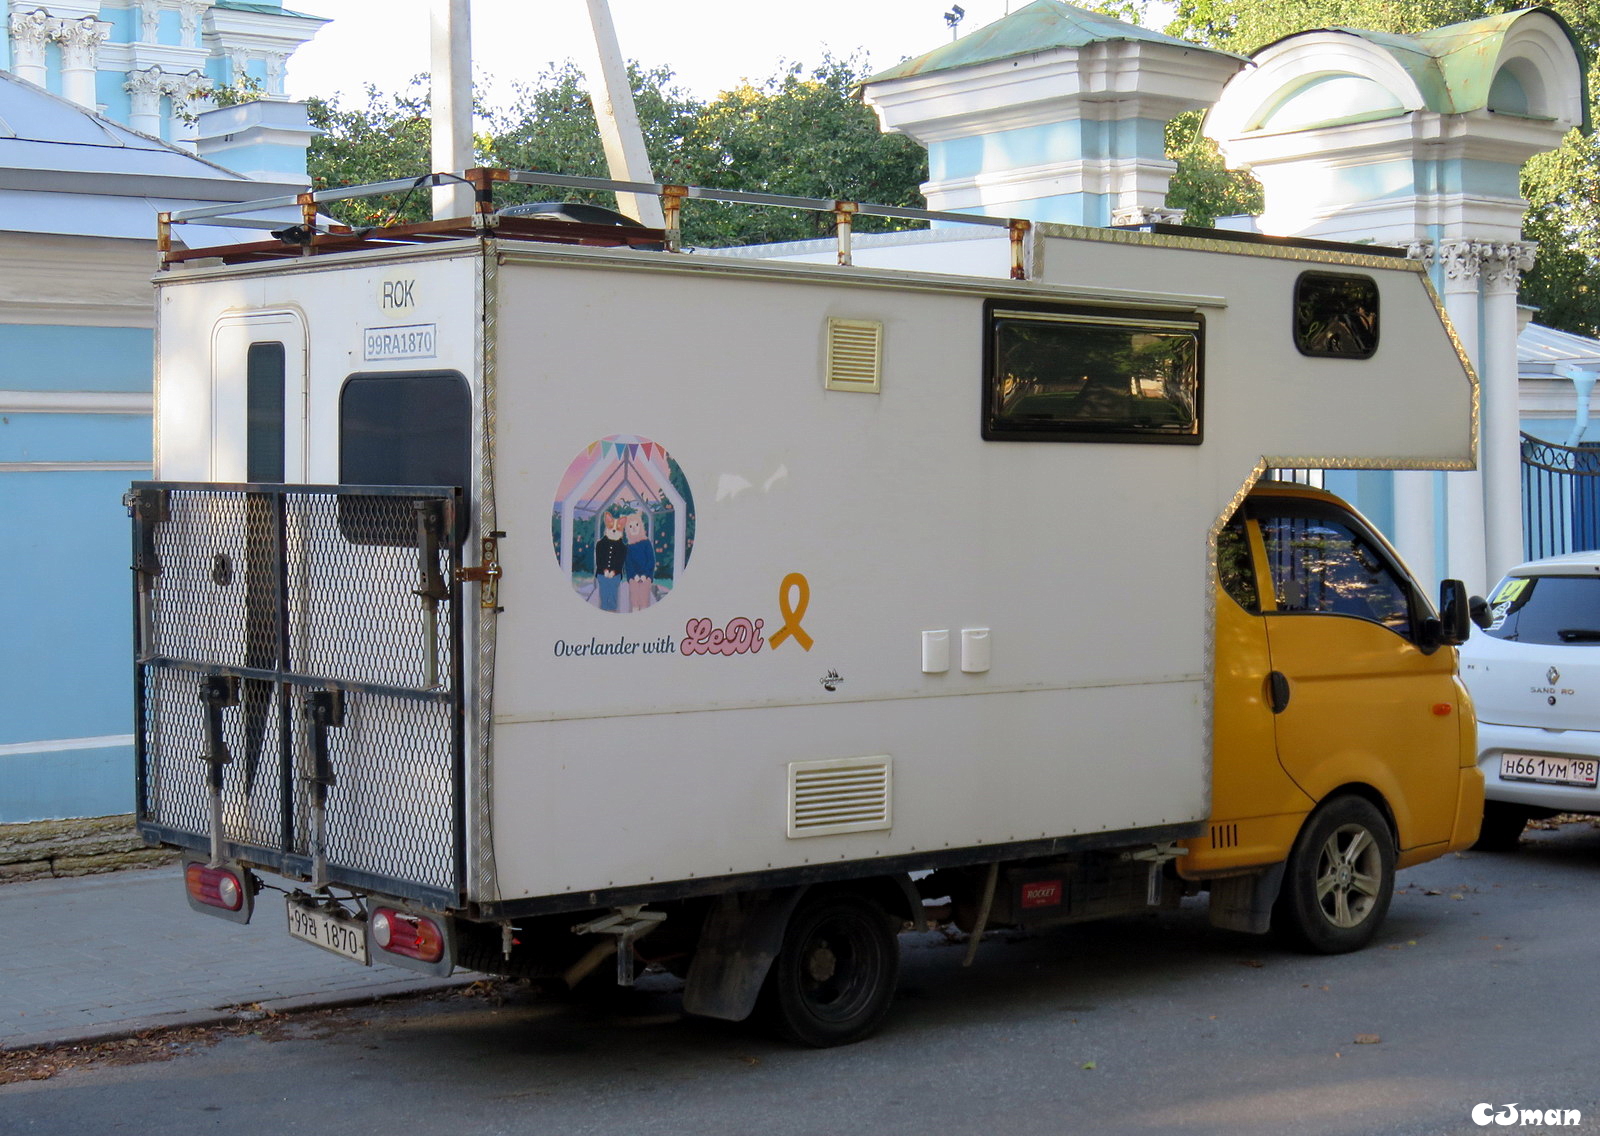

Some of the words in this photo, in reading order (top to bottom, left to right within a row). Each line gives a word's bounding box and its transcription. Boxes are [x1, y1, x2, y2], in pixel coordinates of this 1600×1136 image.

[383, 279, 415, 309] ROK
[367, 331, 432, 356] 99RA1870
[553, 636, 641, 657] Overlander
[643, 634, 676, 655] with
[680, 617, 764, 656] LeDi
[1570, 760, 1594, 776] 198
[1026, 887, 1056, 900] ROCKET
[323, 921, 358, 955] 1870
